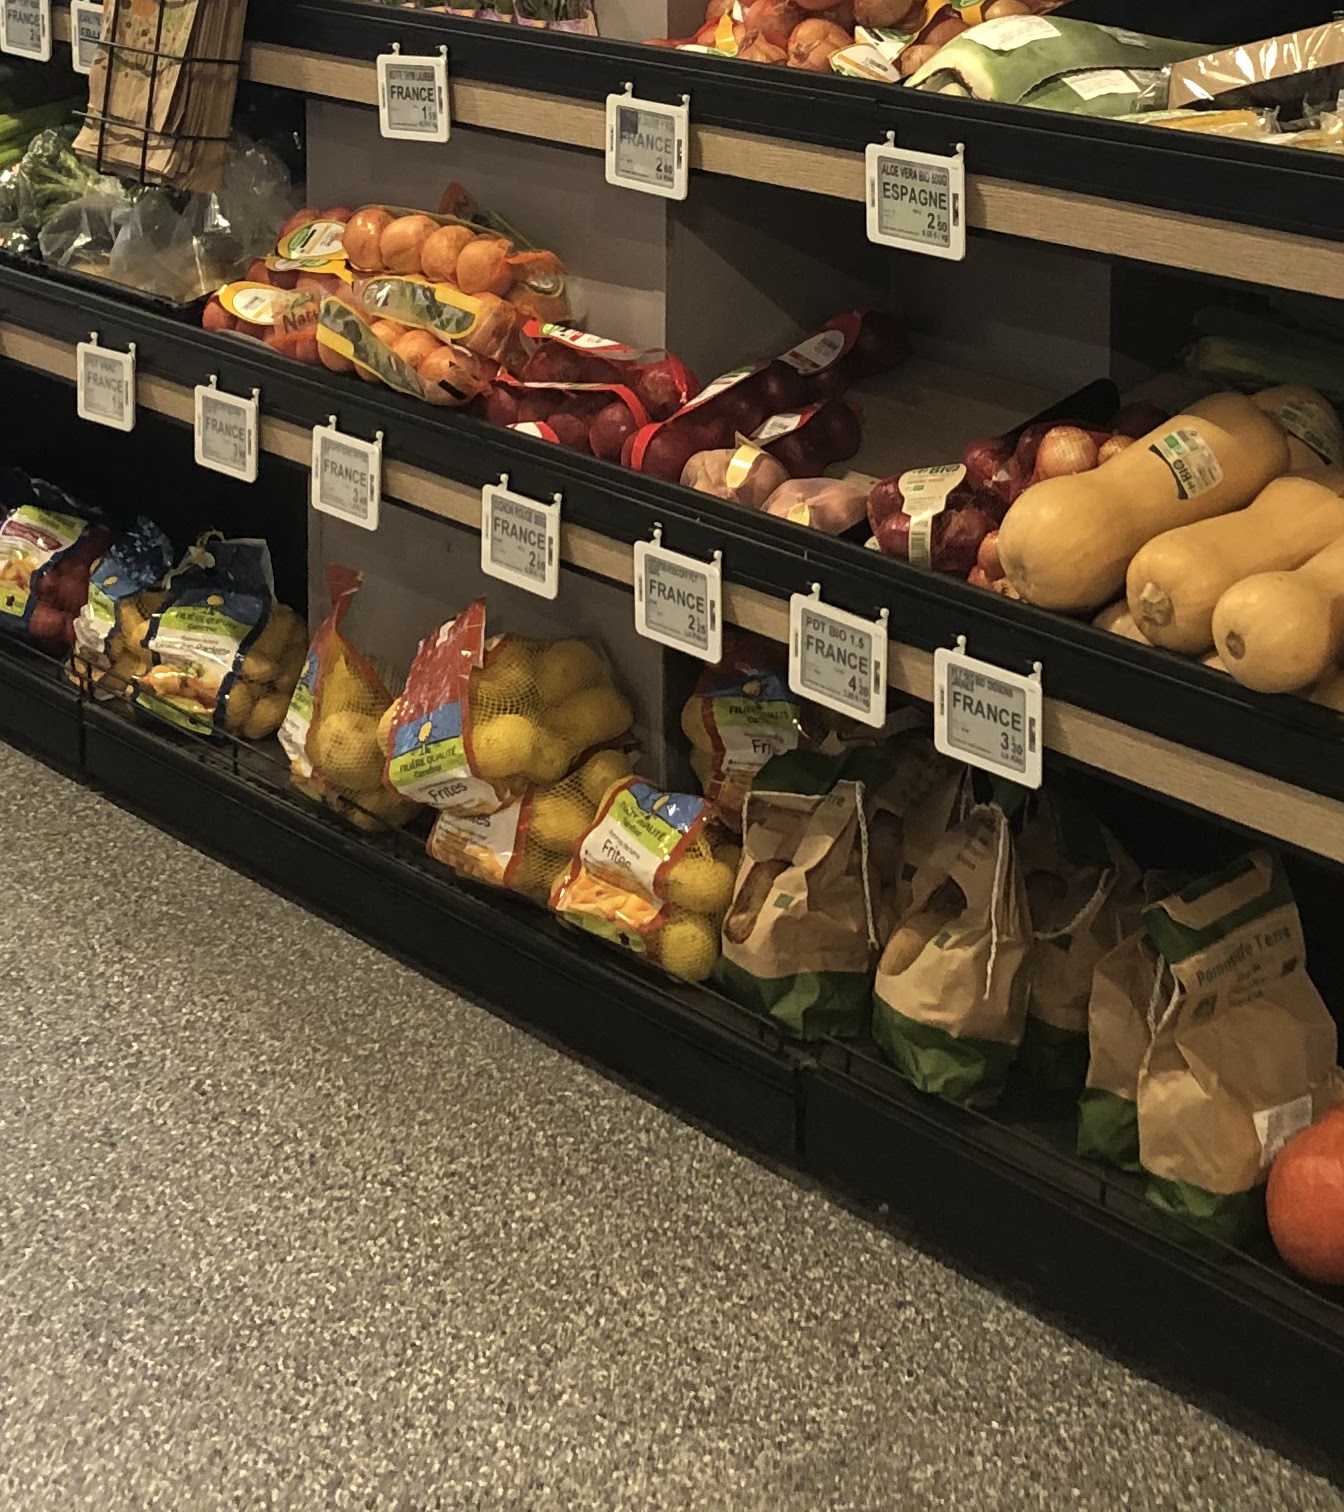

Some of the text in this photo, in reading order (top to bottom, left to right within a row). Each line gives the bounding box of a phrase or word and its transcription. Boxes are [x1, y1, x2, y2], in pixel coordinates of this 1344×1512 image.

[7, 8, 40, 26] FRANCE
[390, 85, 435, 102] FRANCE
[620, 131, 672, 154] FRANCE
[881, 164, 898, 177] ALOE
[900, 168, 917, 180] VERA
[883, 182, 947, 210] ESPAGNE
[88, 371, 123, 393] FRANCE
[207, 418, 245, 441] FRANCE
[324, 459, 367, 487] FRANCE
[494, 517, 545, 550] FRANCE
[649, 579, 705, 614] FRANCE
[807, 615, 825, 634] PDT
[829, 624, 847, 642] BIO
[807, 635, 868, 675] FRANCE
[953, 691, 1022, 732] FRANCE
[426, 745, 455, 764] QUALITÉ
[752, 738, 772, 755] Fri
[428, 782, 467, 802] Frites
[602, 839, 632, 869] Frites
